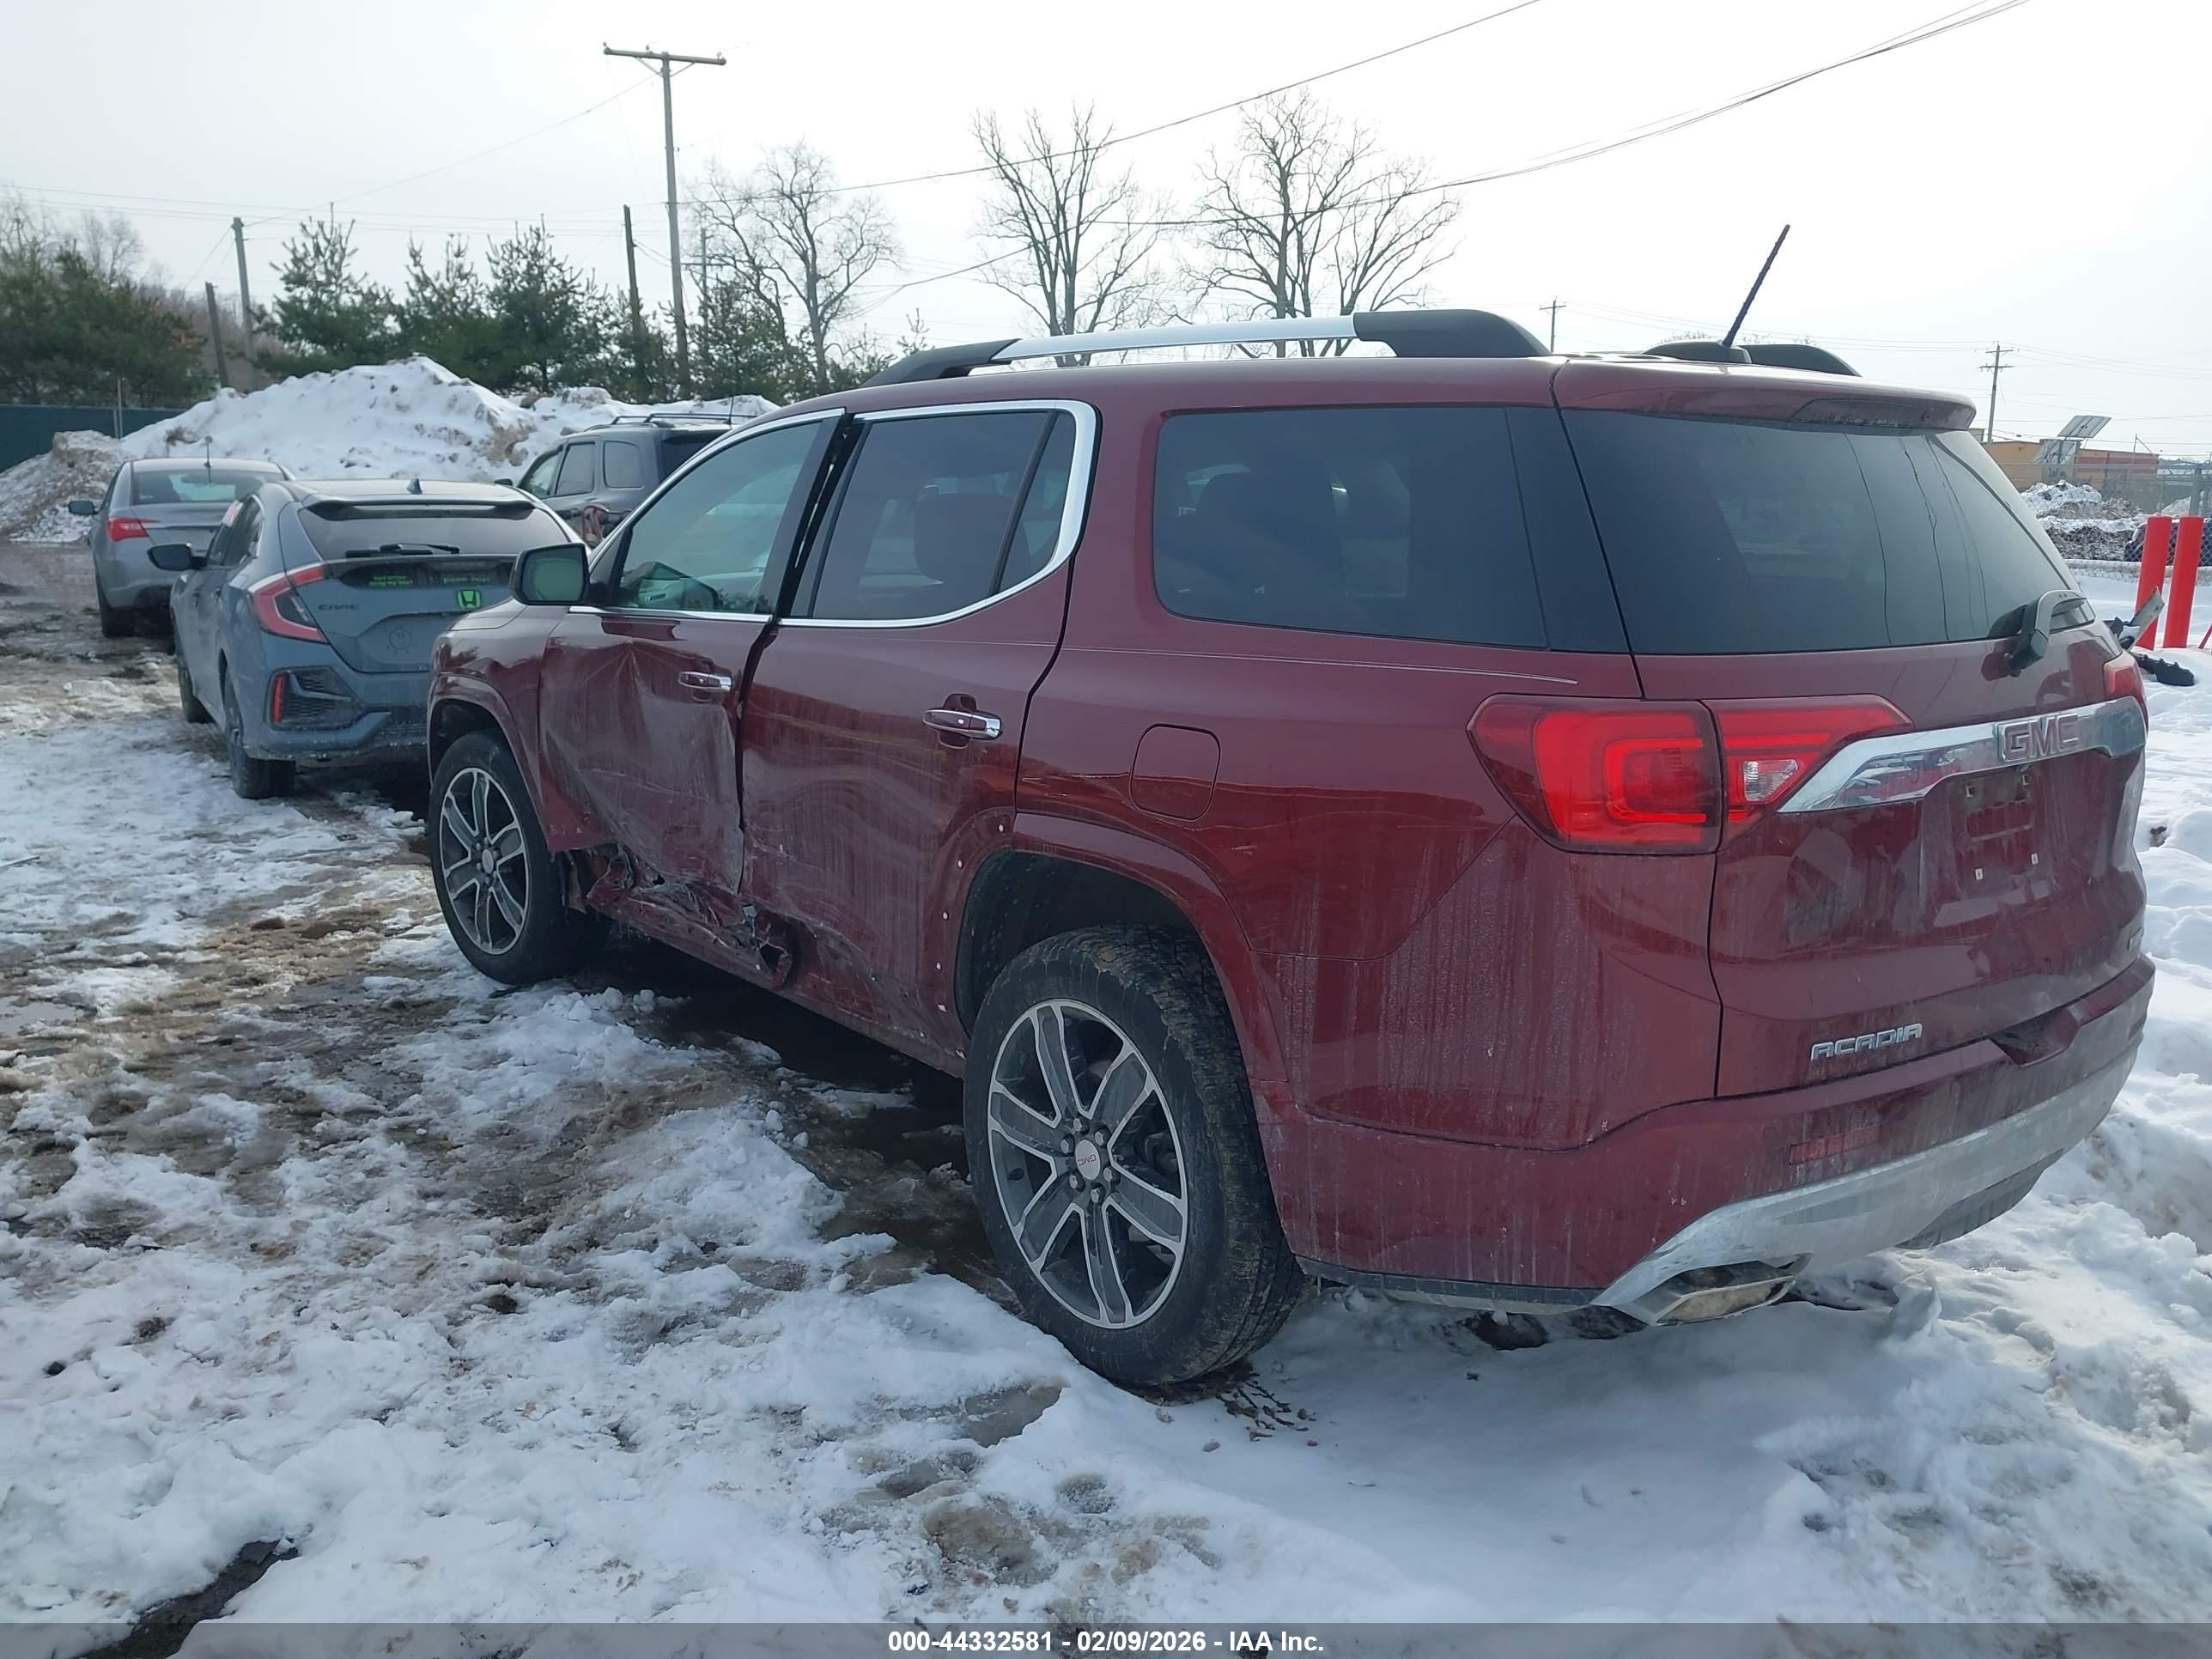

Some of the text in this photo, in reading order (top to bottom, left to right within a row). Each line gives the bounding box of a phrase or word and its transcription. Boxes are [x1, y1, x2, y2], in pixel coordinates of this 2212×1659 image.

[2002, 714, 2079, 762] GMC
[1810, 1023, 1923, 1061] ACADIA
[1078, 1154, 1097, 1167] GMC
